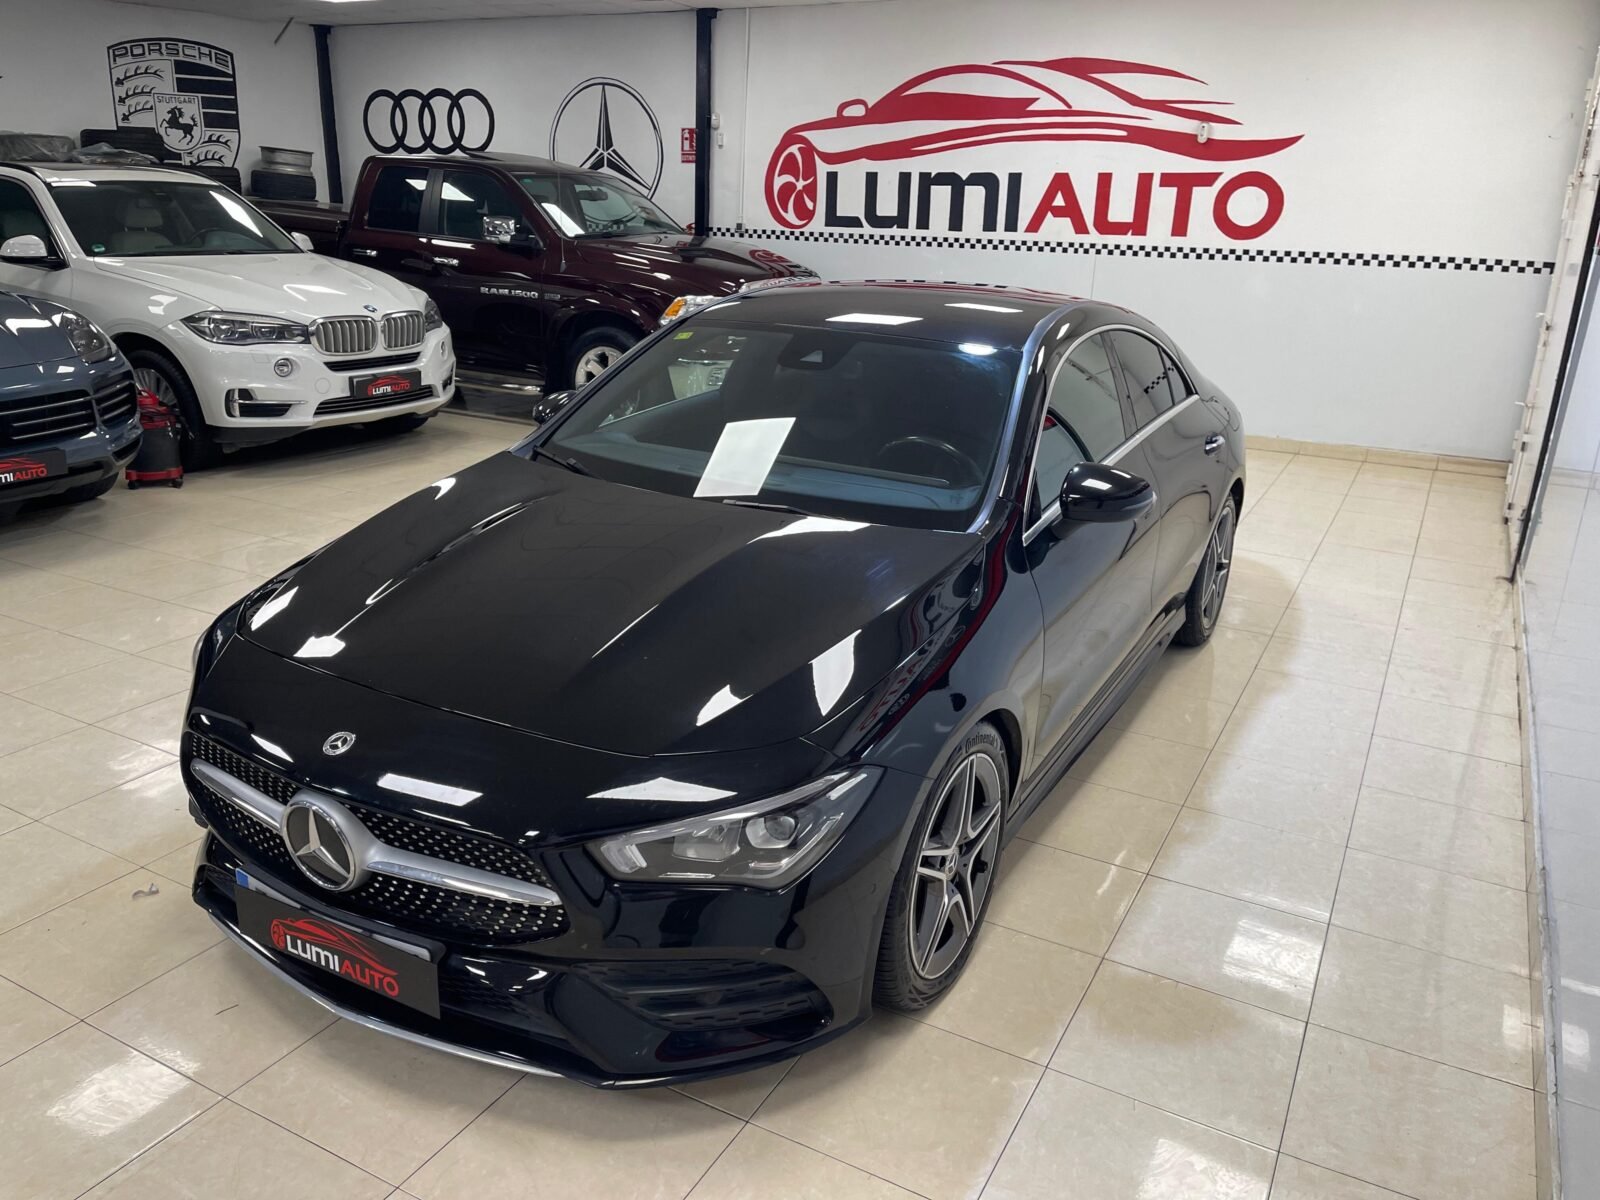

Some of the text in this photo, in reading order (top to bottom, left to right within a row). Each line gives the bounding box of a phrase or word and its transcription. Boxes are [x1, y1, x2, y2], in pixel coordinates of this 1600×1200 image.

[112, 42, 231, 71] PORSCHE
[156, 95, 196, 105] STUTTGART
[480, 286, 509, 296] RAM
[510, 289, 539, 299] 1500
